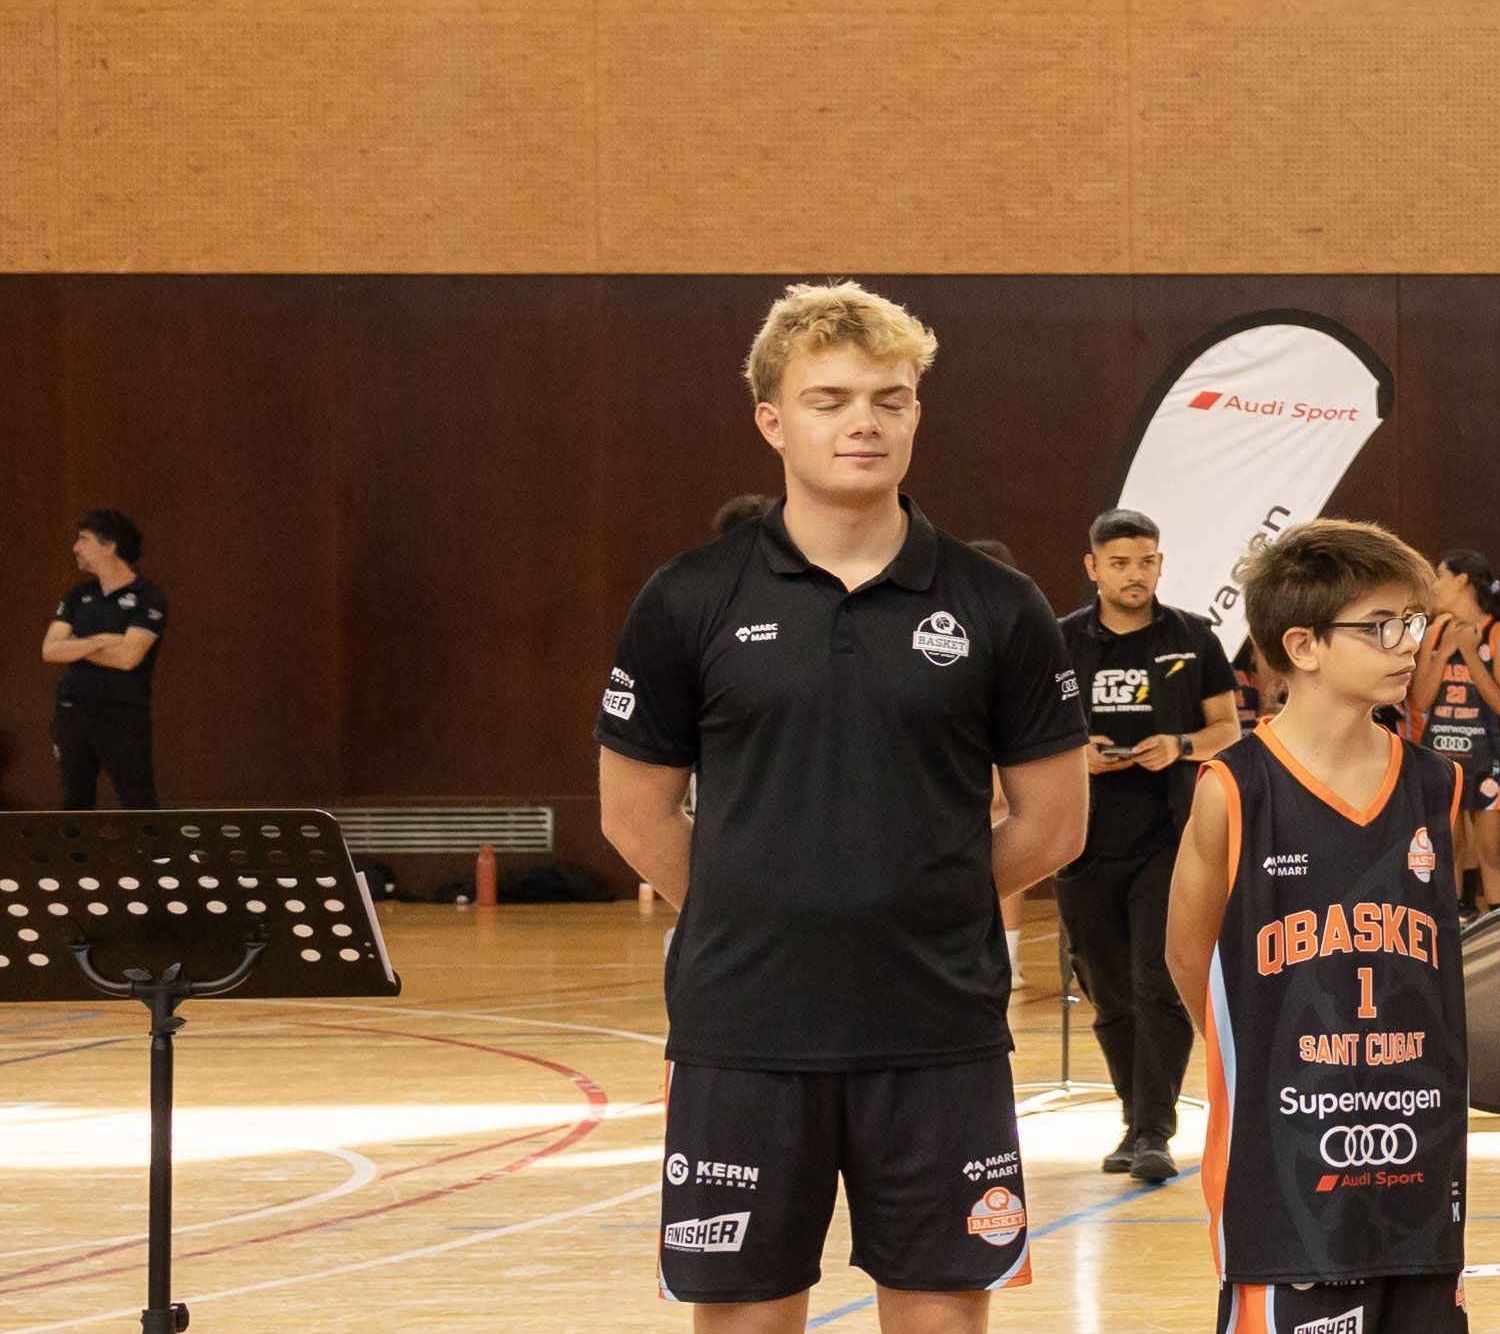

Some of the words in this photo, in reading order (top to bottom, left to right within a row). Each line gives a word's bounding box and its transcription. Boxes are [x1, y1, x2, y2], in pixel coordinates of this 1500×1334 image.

[1222, 394, 1284, 417] Audi
[1291, 401, 1359, 423] Sport
[750, 623, 779, 632] MARC
[750, 632, 779, 641] MART
[917, 635, 966, 652] BASKET
[1276, 854, 1309, 864] MARC
[1276, 866, 1308, 876] MART
[1256, 902, 1439, 976] QBASKET
[1357, 967, 1378, 1018] 1
[1299, 1033, 1360, 1066] SANT
[1365, 1032, 1425, 1066] CUGAT
[1279, 1086, 1441, 1119] Superwagen
[985, 1151, 1018, 1167] MARC
[696, 1160, 760, 1182] KERN
[986, 1164, 1019, 1180] MART
[1341, 1172, 1371, 1187] Audi
[1375, 1171, 1424, 1187] Sport
[696, 1178, 757, 1190] PHARMA
[971, 1214, 1025, 1232] BASKET
[667, 1220, 739, 1246] FINISHER
